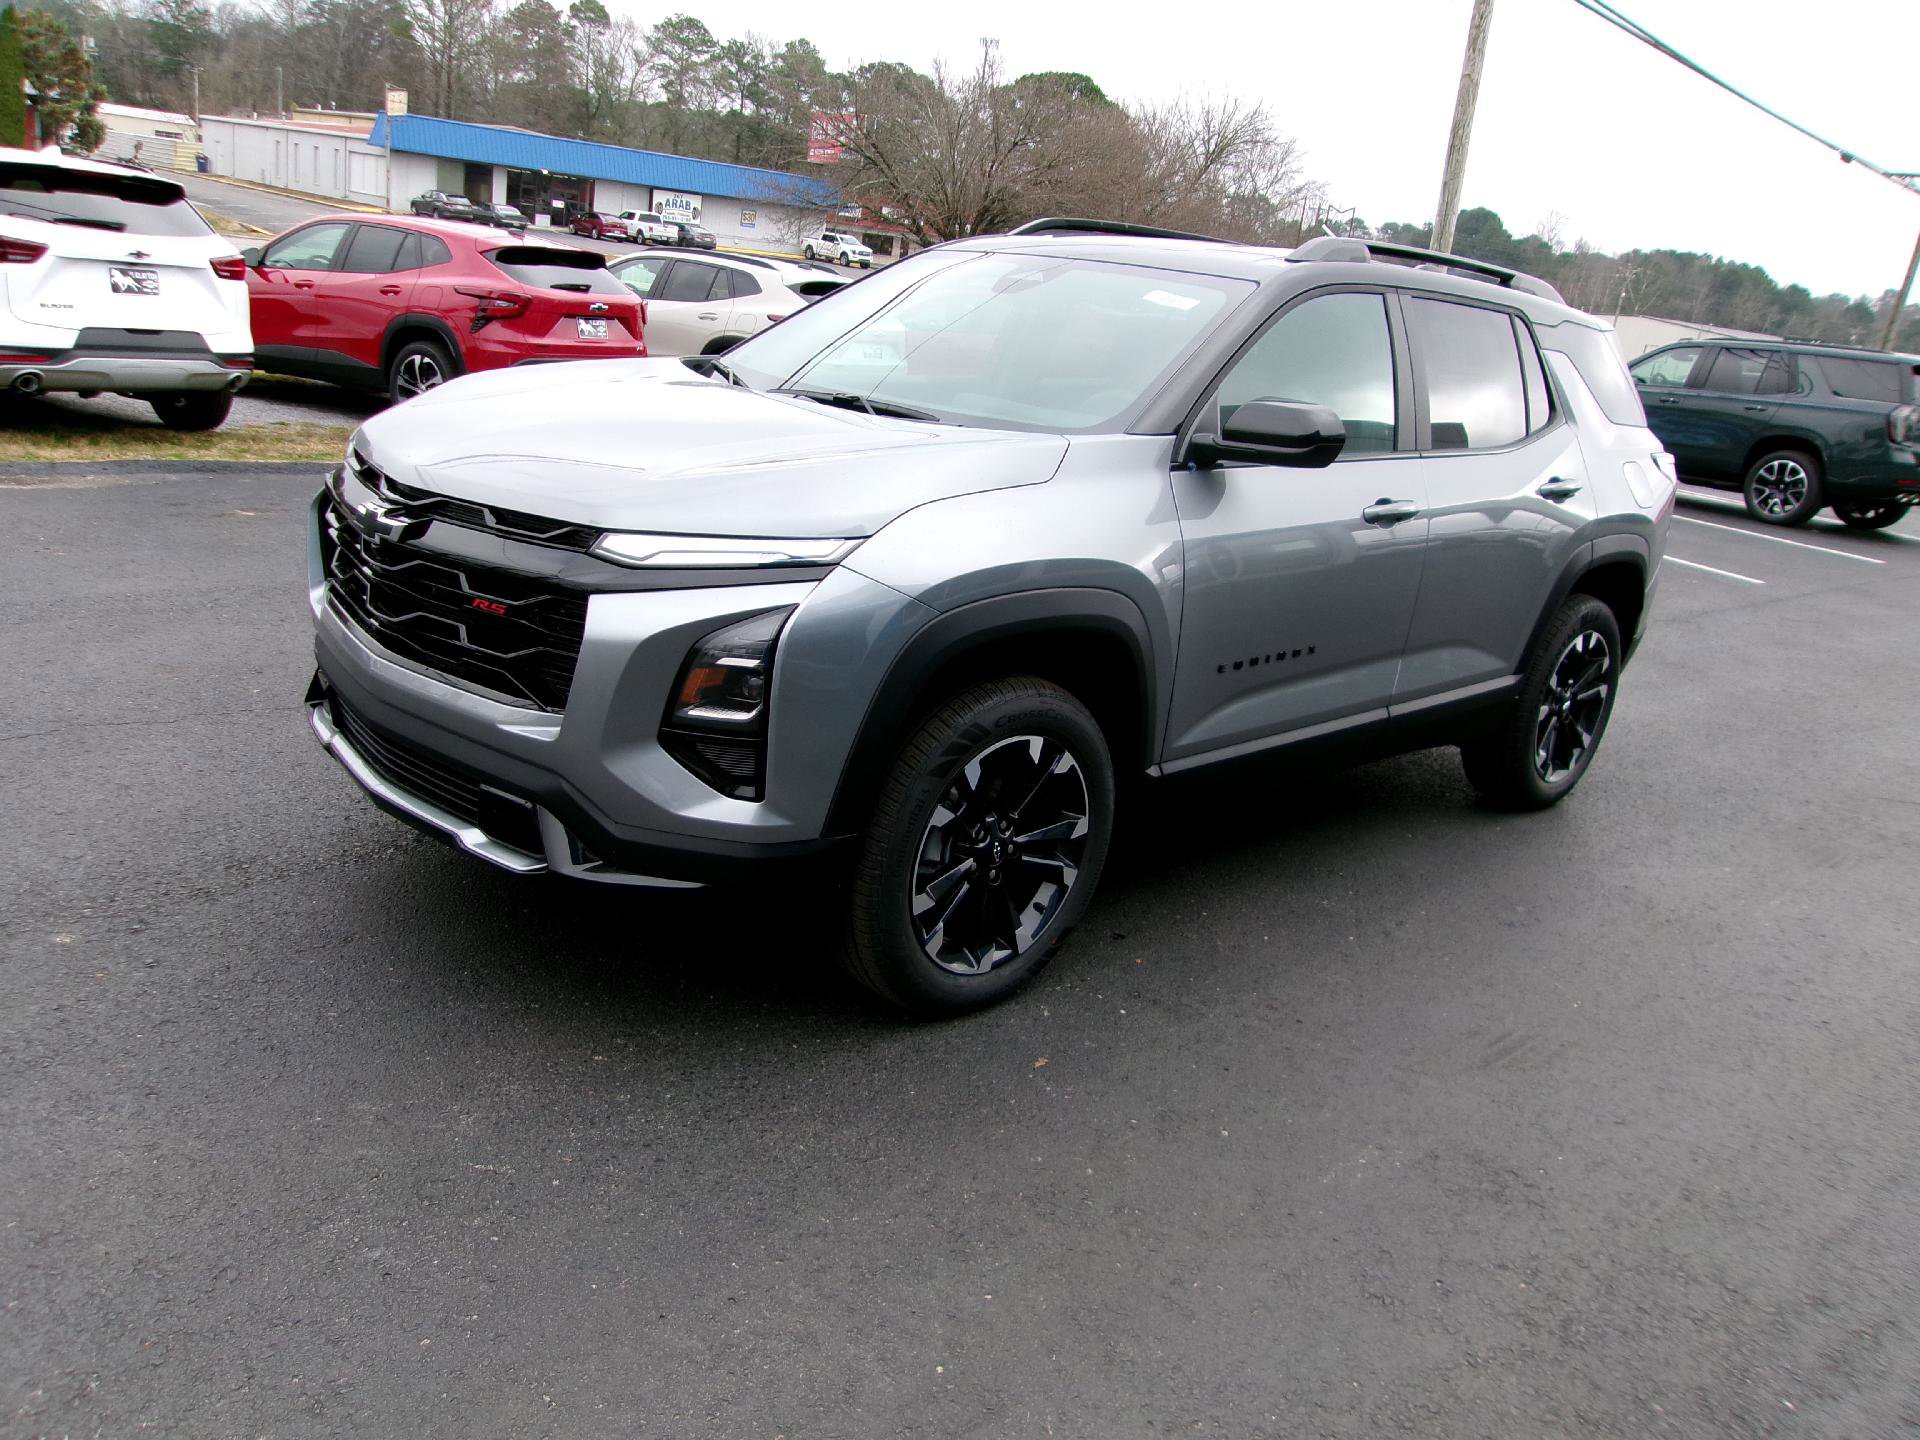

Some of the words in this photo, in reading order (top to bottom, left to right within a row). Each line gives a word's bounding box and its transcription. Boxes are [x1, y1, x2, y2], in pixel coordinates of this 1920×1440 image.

[664, 198, 692, 211] ARAB
[472, 598, 506, 615] RS
[1217, 645, 1316, 674] EQUINOX
